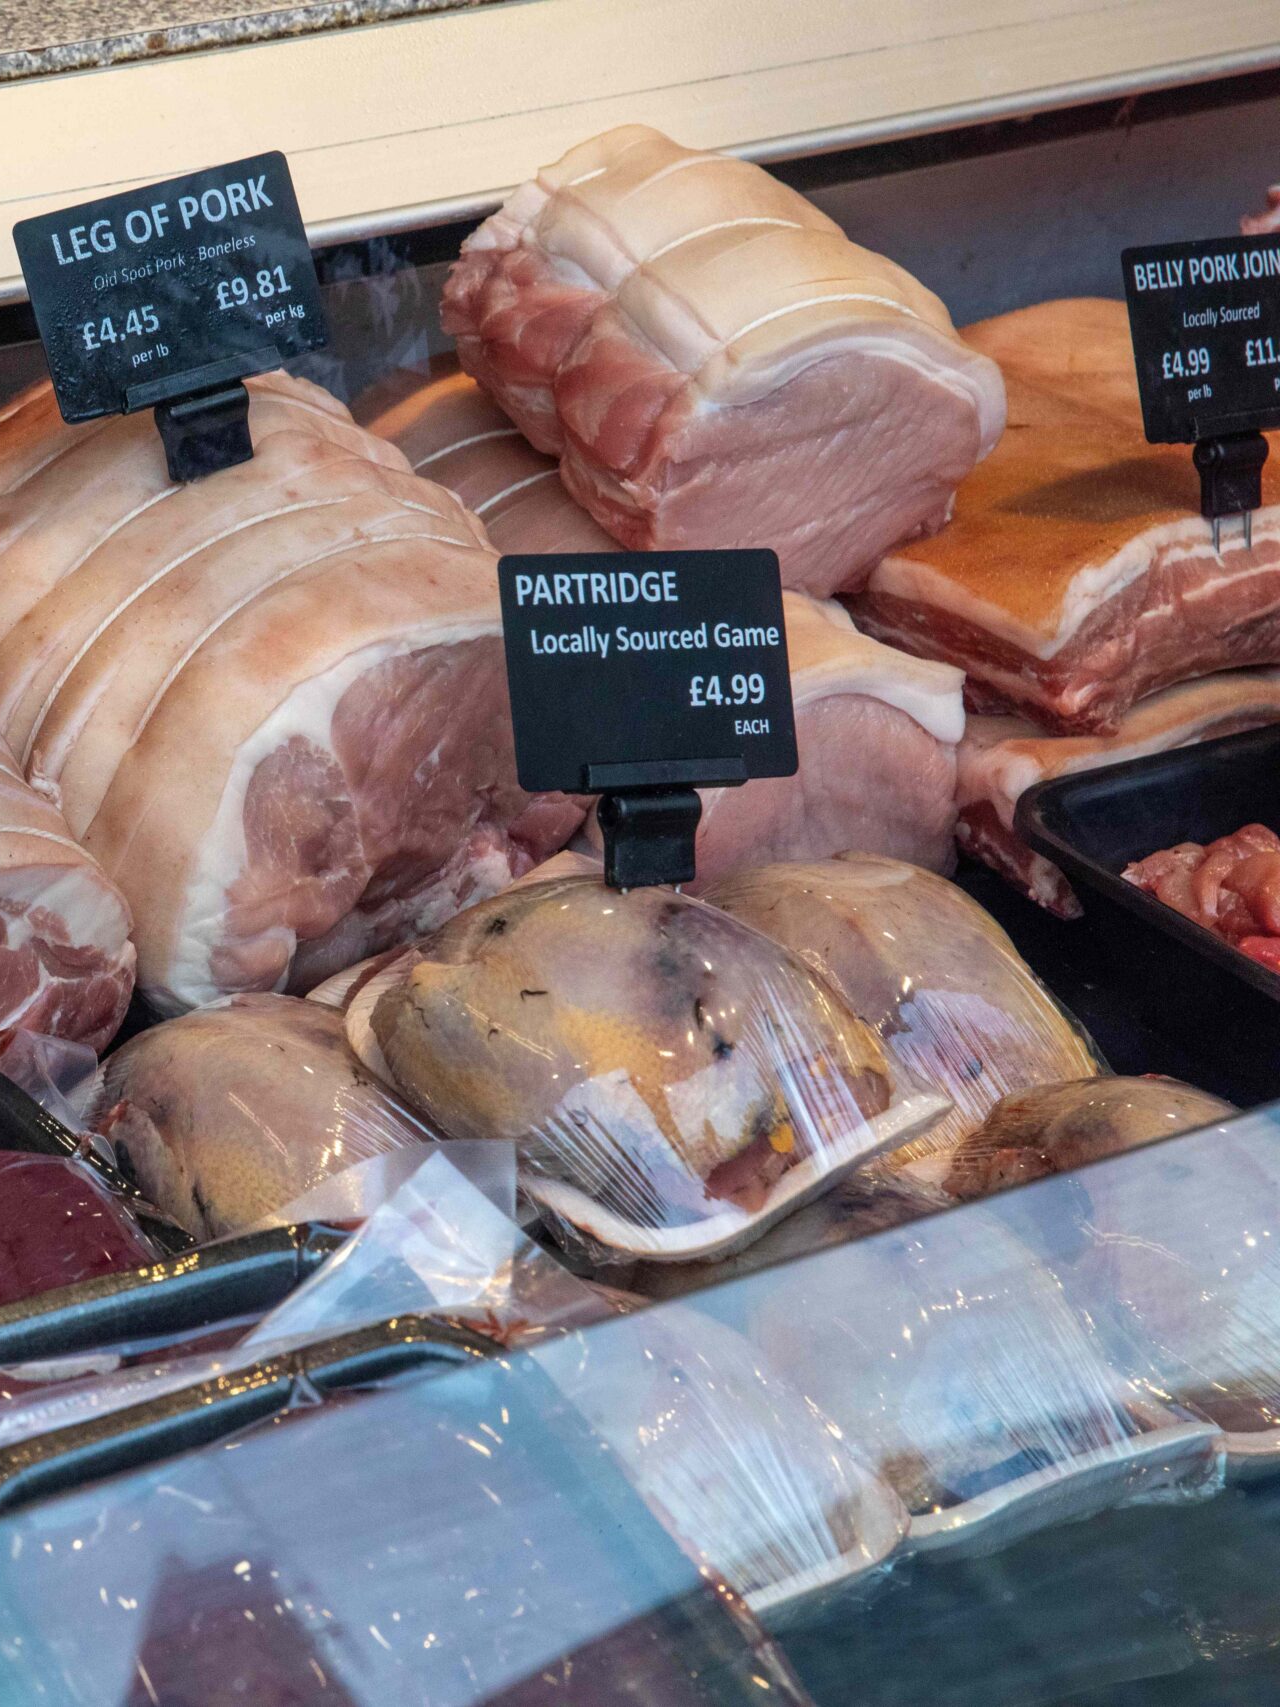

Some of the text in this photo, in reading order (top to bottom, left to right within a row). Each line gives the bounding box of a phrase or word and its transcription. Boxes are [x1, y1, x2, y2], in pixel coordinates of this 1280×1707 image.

[51, 175, 274, 266] LEG OF PORK
[121, 263, 153, 285] Spot
[155, 254, 186, 273] Pork
[198, 234, 257, 261] Boneless
[1133, 257, 1184, 292] BELLY
[1188, 252, 1241, 286] PORK
[82, 264, 292, 351] £4.45 £9.81
[1183, 301, 1260, 329] Locally Sourced
[131, 303, 306, 368] per lb per kg
[1162, 347, 1210, 380] £4.99
[1187, 384, 1213, 403] per lb
[515, 571, 679, 606] PARTRIDGE
[530, 622, 780, 659] Locally Sourced Game
[689, 673, 765, 707] £4.99
[734, 718, 770, 735] EACH
